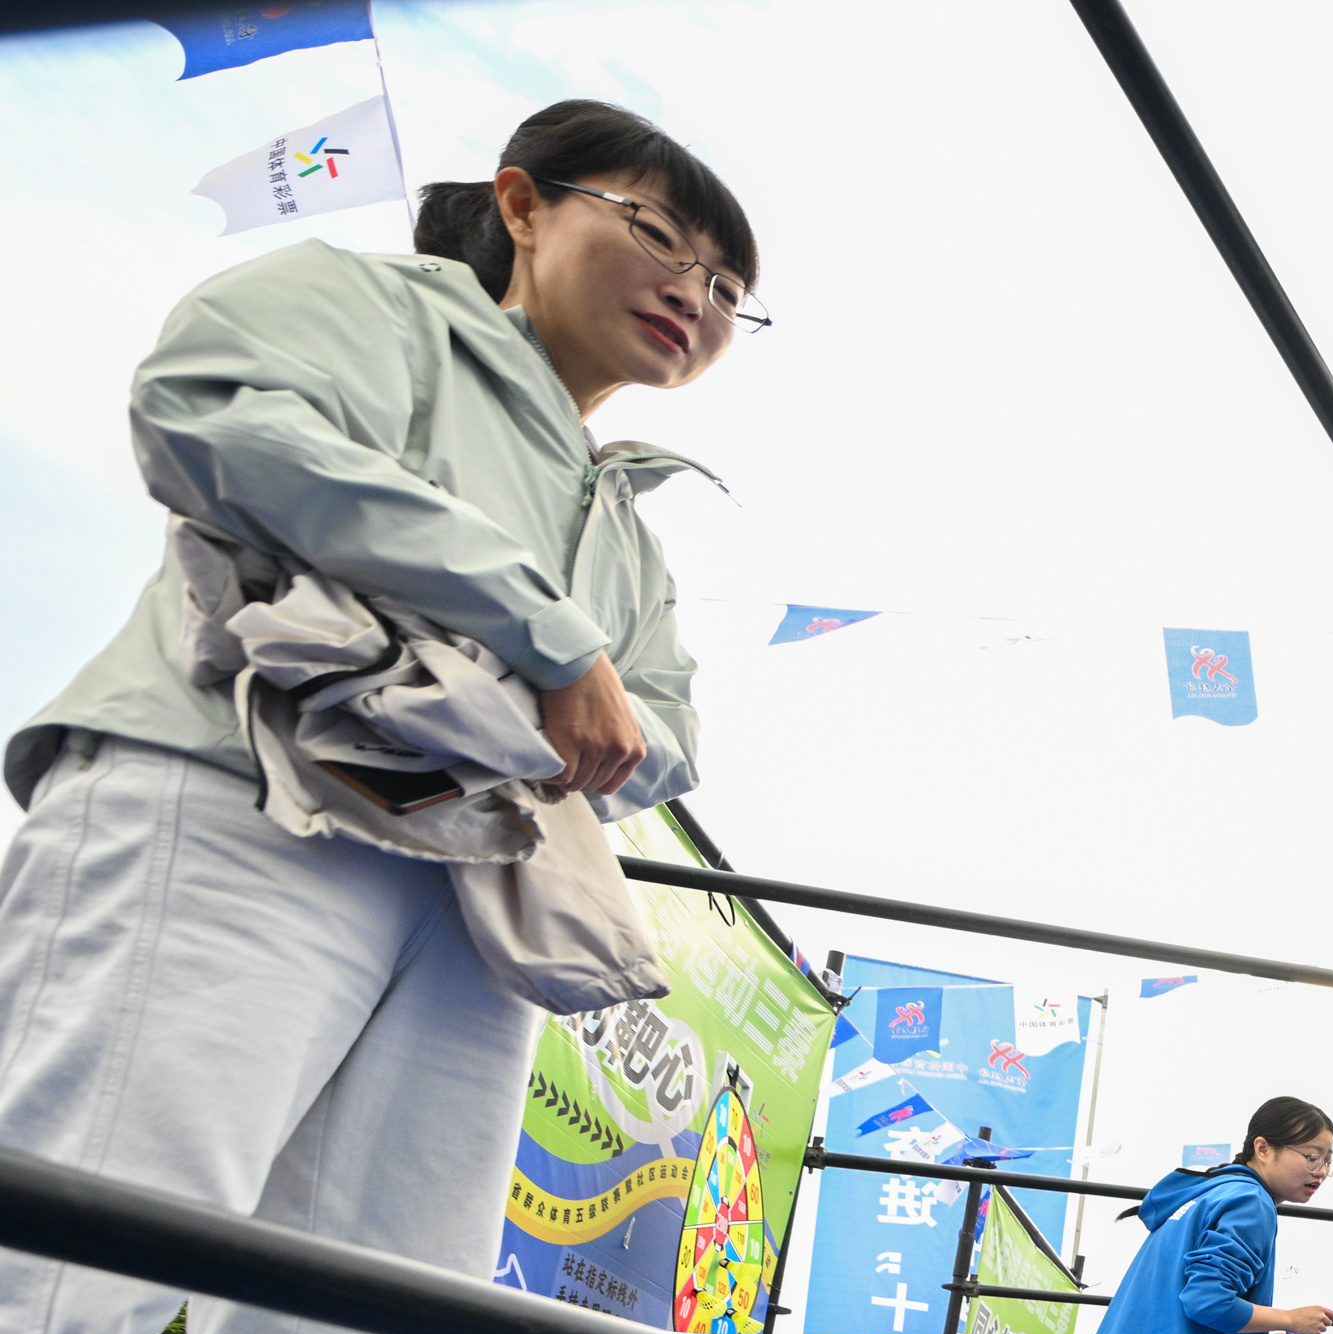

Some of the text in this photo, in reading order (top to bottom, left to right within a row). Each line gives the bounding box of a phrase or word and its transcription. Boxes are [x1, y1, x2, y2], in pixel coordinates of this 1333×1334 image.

[266, 137, 298, 216] 中国体育彩票
[750, 1183, 759, 1205] 60
[750, 1238, 760, 1260] 10
[562, 1253, 639, 1312] 站在指定标线外
[680, 1295, 691, 1319] 10
[737, 1287, 750, 1310] 50
